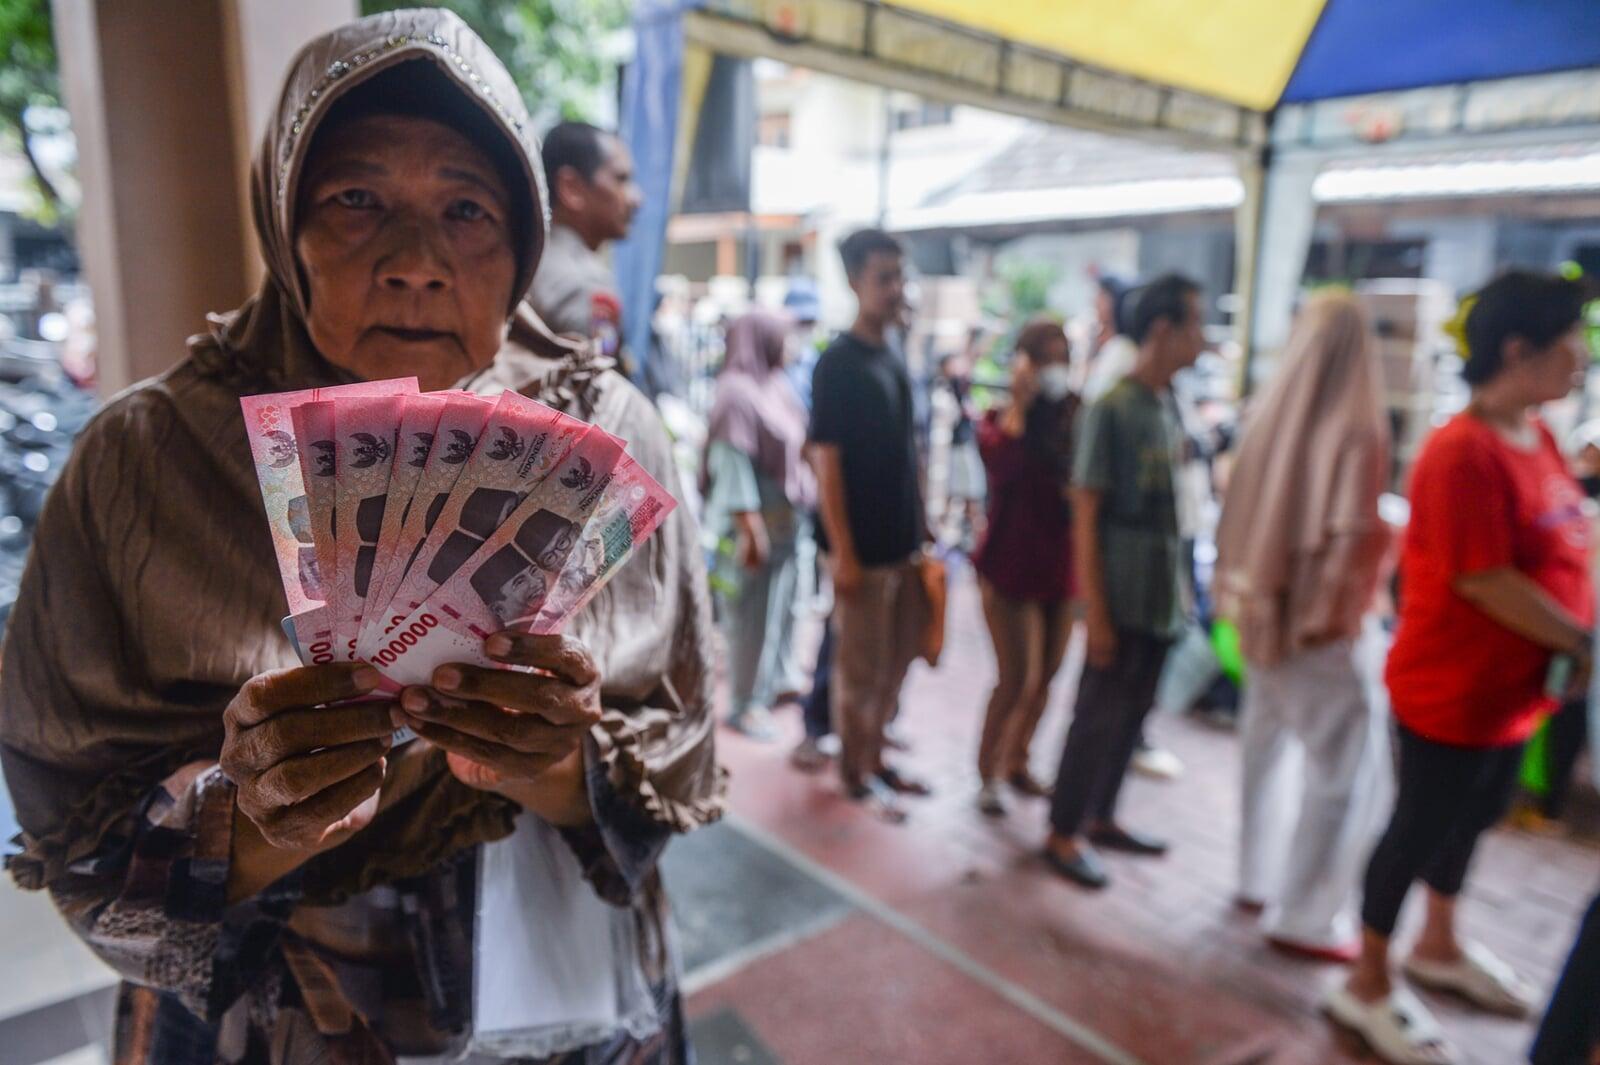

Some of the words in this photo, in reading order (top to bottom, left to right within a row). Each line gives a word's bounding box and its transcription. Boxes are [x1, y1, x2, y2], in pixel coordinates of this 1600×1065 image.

[519, 432, 548, 479] INDONESIA
[579, 472, 616, 511] INDONESIA
[370, 613, 438, 668] 100000
